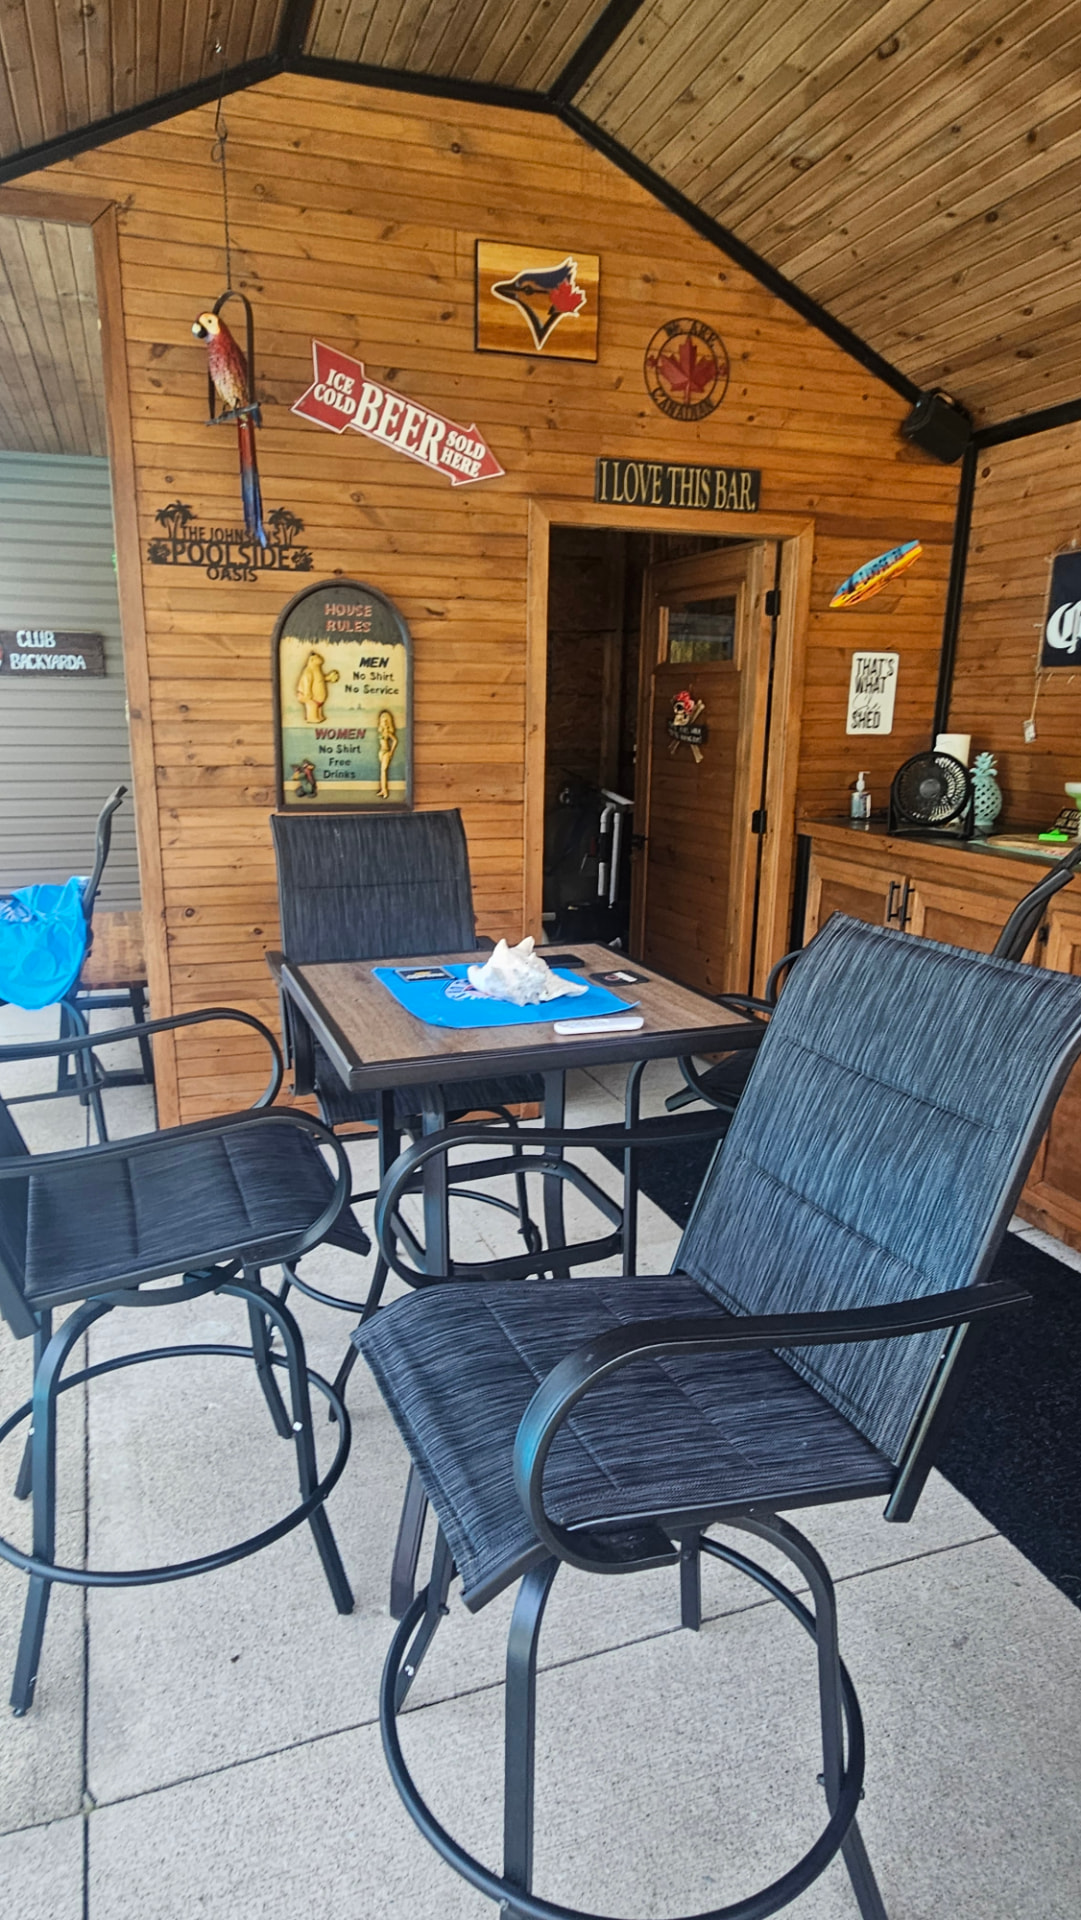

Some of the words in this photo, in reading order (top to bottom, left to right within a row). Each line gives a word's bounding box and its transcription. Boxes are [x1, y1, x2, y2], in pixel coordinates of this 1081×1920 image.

[325, 368, 356, 395] ICE
[313, 385, 357, 416] COLD
[350, 382, 446, 465] BEER
[445, 430, 486, 461] SOLD
[439, 447, 483, 478] HERE
[600, 460, 608, 501] I
[612, 461, 663, 505] LOVE
[667, 466, 711, 508] THIS
[181, 526, 206, 541] THE
[172, 541, 290, 568] POOLSIDE
[206, 567, 258, 582] OASIS
[324, 603, 373, 617] HOUSE
[325, 620, 372, 633] RULES
[16, 629, 57, 648] CLUB
[9, 652, 87, 671] BACKYARDA
[359, 656, 390, 668] MEN
[857, 658, 895, 677] THAT'S
[352, 671, 367, 681] No
[369, 671, 395, 682] Shirt
[855, 676, 887, 694] WHAT
[344, 683, 360, 694] No
[363, 684, 400, 695] Service
[851, 710, 882, 729] SHED
[315, 727, 367, 740] WOMEN
[318, 744, 333, 754] No
[335, 744, 362, 754] Shirt
[328, 757, 351, 767] Free
[323, 769, 356, 779] Drinks
